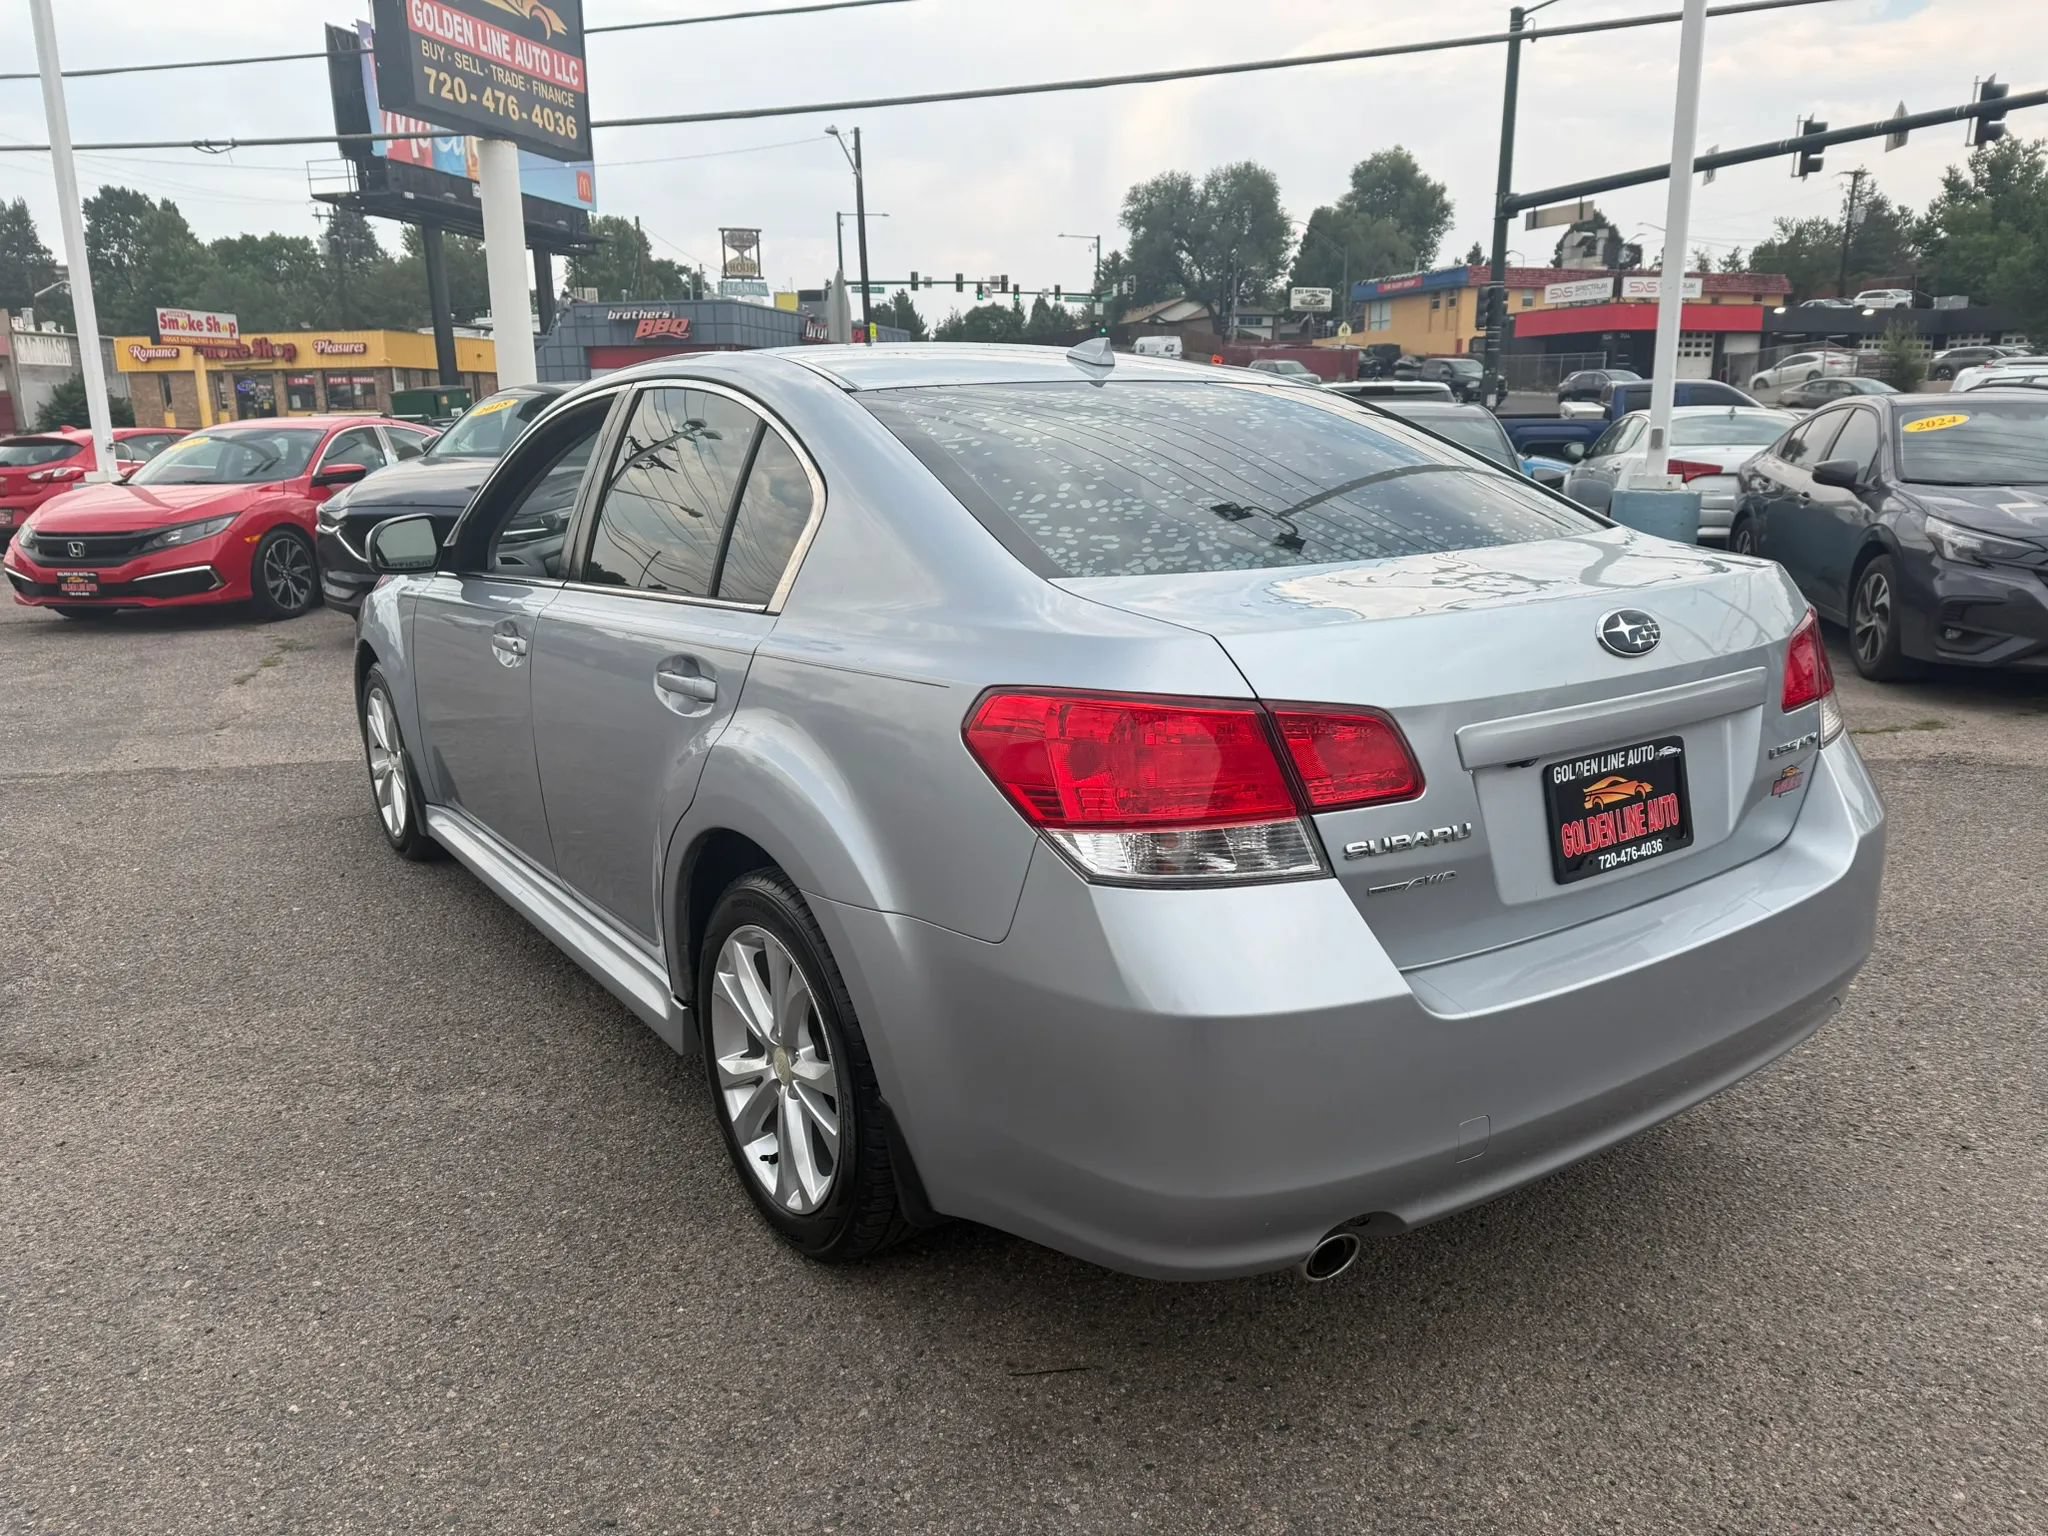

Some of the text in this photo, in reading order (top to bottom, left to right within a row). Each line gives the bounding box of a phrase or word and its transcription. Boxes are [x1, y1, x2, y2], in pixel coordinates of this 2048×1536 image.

[411, 0, 579, 86] GOLDEN LINE AUTO LLC
[421, 39, 575, 109] BUY SELL TRADE FINANCE
[730, 263, 756, 273] HOUR
[160, 312, 236, 337] Smoke Shop
[607, 309, 670, 320] brothers
[635, 318, 689, 339] BBQ
[128, 345, 178, 362] Romance
[252, 336, 297, 362] Shop
[313, 340, 365, 354] Pleasures
[1916, 415, 1957, 431] 2024
[1553, 745, 1655, 784] GOLDEN LINE AUTO
[1561, 792, 1680, 858] GOLDEN LINE AUTO
[1344, 822, 1472, 860] SUBARU
[1598, 839, 1663, 870] 720-476-4036
